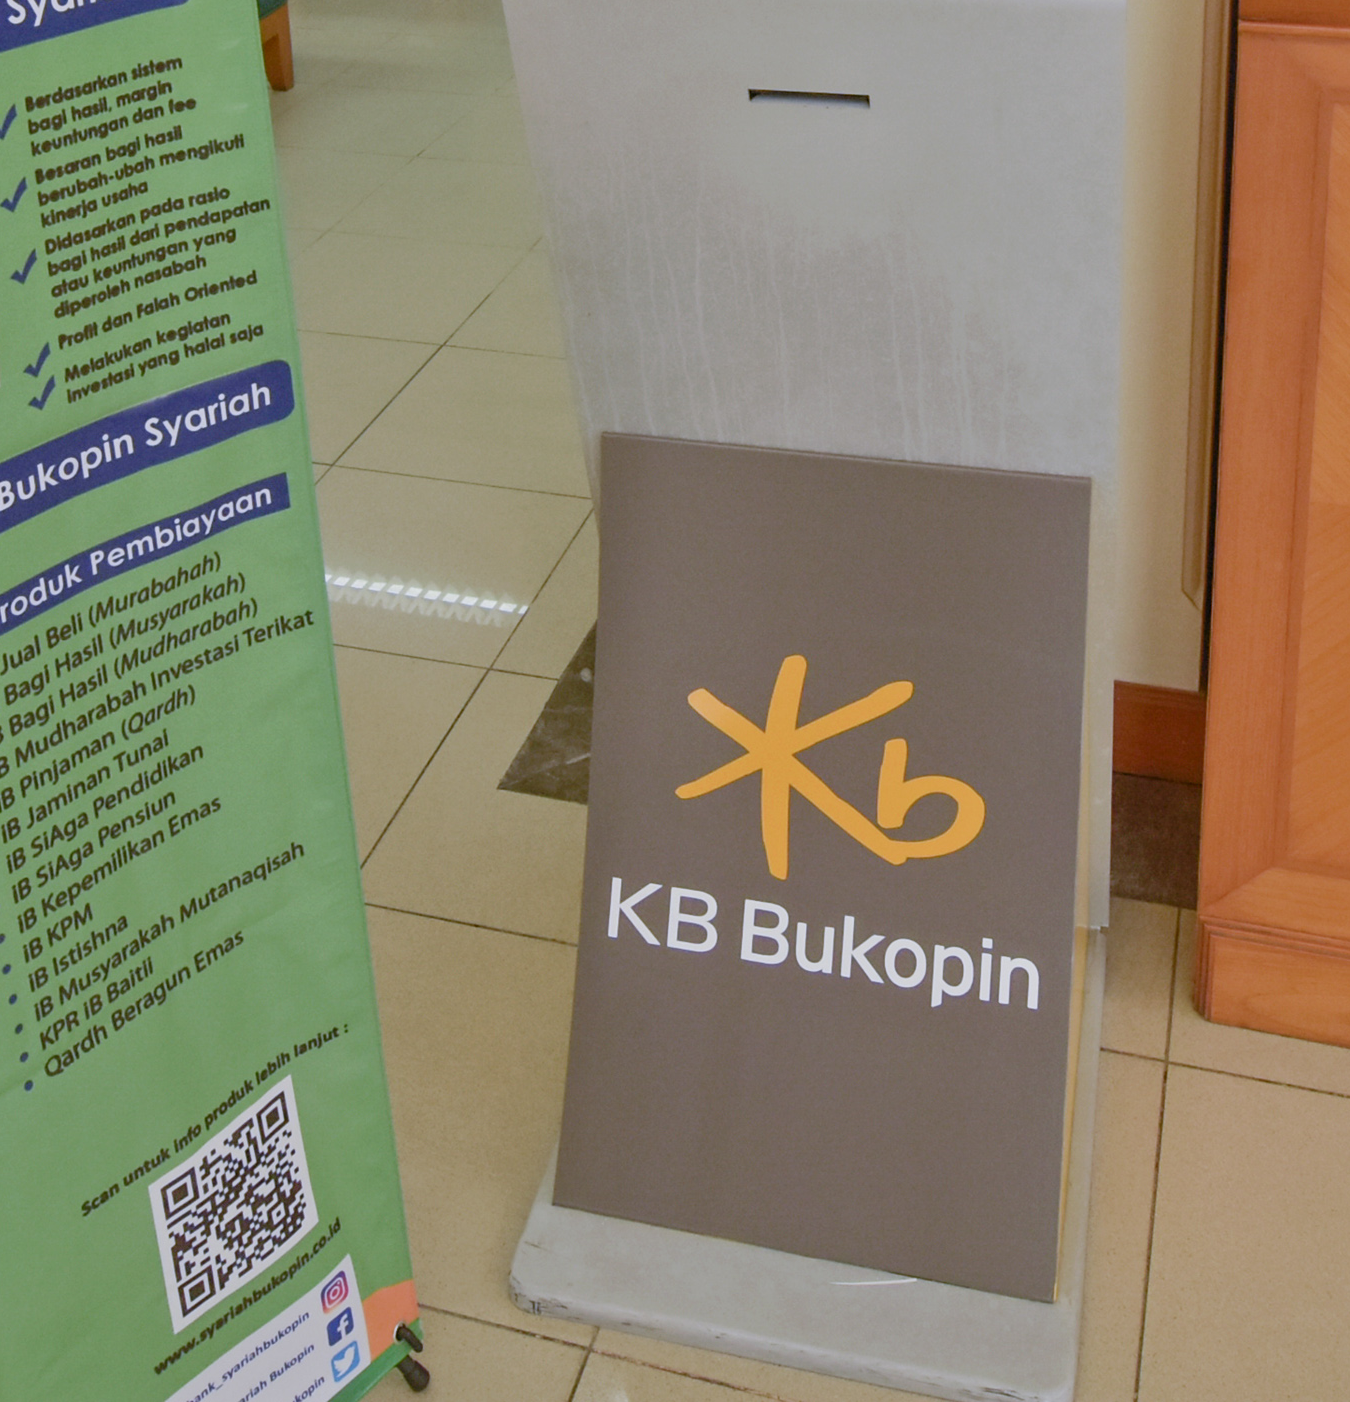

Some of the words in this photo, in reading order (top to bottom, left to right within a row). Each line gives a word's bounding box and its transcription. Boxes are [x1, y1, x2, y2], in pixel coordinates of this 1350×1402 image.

[24, 70, 128, 113] Berdasarkan
[130, 56, 183, 80] sistem
[27, 108, 67, 135] bagi
[70, 96, 112, 121] hasil,
[115, 80, 173, 108] margin
[33, 152, 102, 185] Besaran
[104, 135, 141, 162] bagi
[143, 124, 183, 148] hasil
[158, 132, 245, 166] mengikuti
[39, 198, 98, 228] kinerja
[100, 180, 148, 207] usaha
[43, 212, 136, 255] Didasarkan
[139, 196, 185, 224] pada
[187, 185, 230, 207] rasio
[46, 250, 87, 277] bagi
[89, 234, 126, 262] hasil
[129, 222, 160, 246] dari
[163, 198, 271, 238] pendapatan
[57, 321, 98, 350] Profit
[100, 310, 133, 333] dan
[135, 291, 180, 319] Falah
[183, 268, 258, 302] Oriented
[143, 382, 271, 446] Syariah
[90, 488, 271, 575] Pembiayaan
[0, 634, 41, 676] Jual
[45, 611, 83, 649] Beli
[87, 550, 221, 628] (Murabahah)
[3, 663, 50, 706] Bagi
[54, 632, 104, 678] Hasil
[108, 571, 245, 650] (Musyarakah)
[14, 680, 148, 768] Mudharabah
[150, 633, 240, 691] Investasi
[244, 609, 315, 650] Terikat
[16, 906, 37, 934] iB
[40, 829, 165, 918] Kepemilikan
[167, 796, 222, 838] Emas
[33, 994, 54, 1022] iB
[58, 915, 175, 1005] Musyarakah
[179, 841, 305, 923] Mutanaqisah
[606, 877, 719, 954] KB
[739, 898, 1041, 1010] Bukopin
[38, 1010, 80, 1051] KPR
[82, 993, 103, 1020] iB
[43, 1024, 108, 1077] Qardh
[110, 965, 191, 1031] Beragun
[193, 930, 244, 973] Emas
[80, 1182, 120, 1217] Scan
[122, 1147, 171, 1187] untuk
[173, 1123, 202, 1153] info
[203, 1079, 254, 1131] produk
[254, 1051, 291, 1086] lebih
[292, 1026, 339, 1058] lanjut
[153, 1216, 341, 1375] www.syariahbukopin.co.id
[268, 1343, 316, 1383] Bukopin
